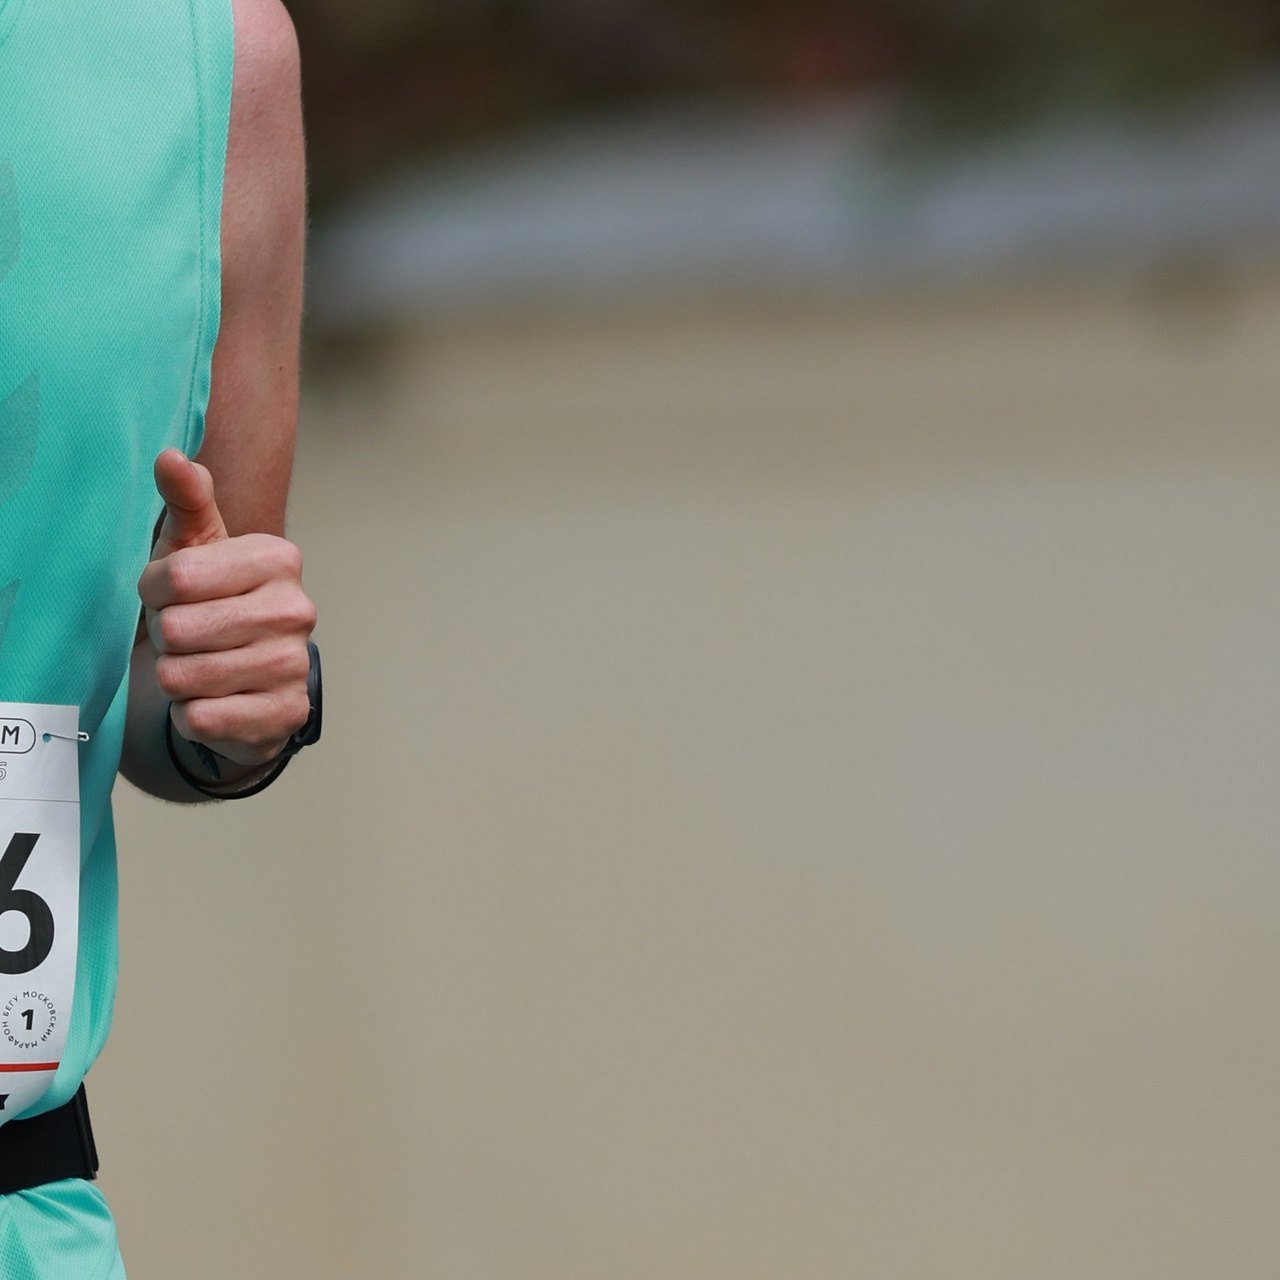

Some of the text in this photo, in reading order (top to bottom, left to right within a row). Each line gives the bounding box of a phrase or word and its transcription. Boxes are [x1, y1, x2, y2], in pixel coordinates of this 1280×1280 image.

[2, 991, 56, 1049] БЕГУ МОСКОВСКИЙ МАРАФОН
[21, 1009, 34, 1030] 1
